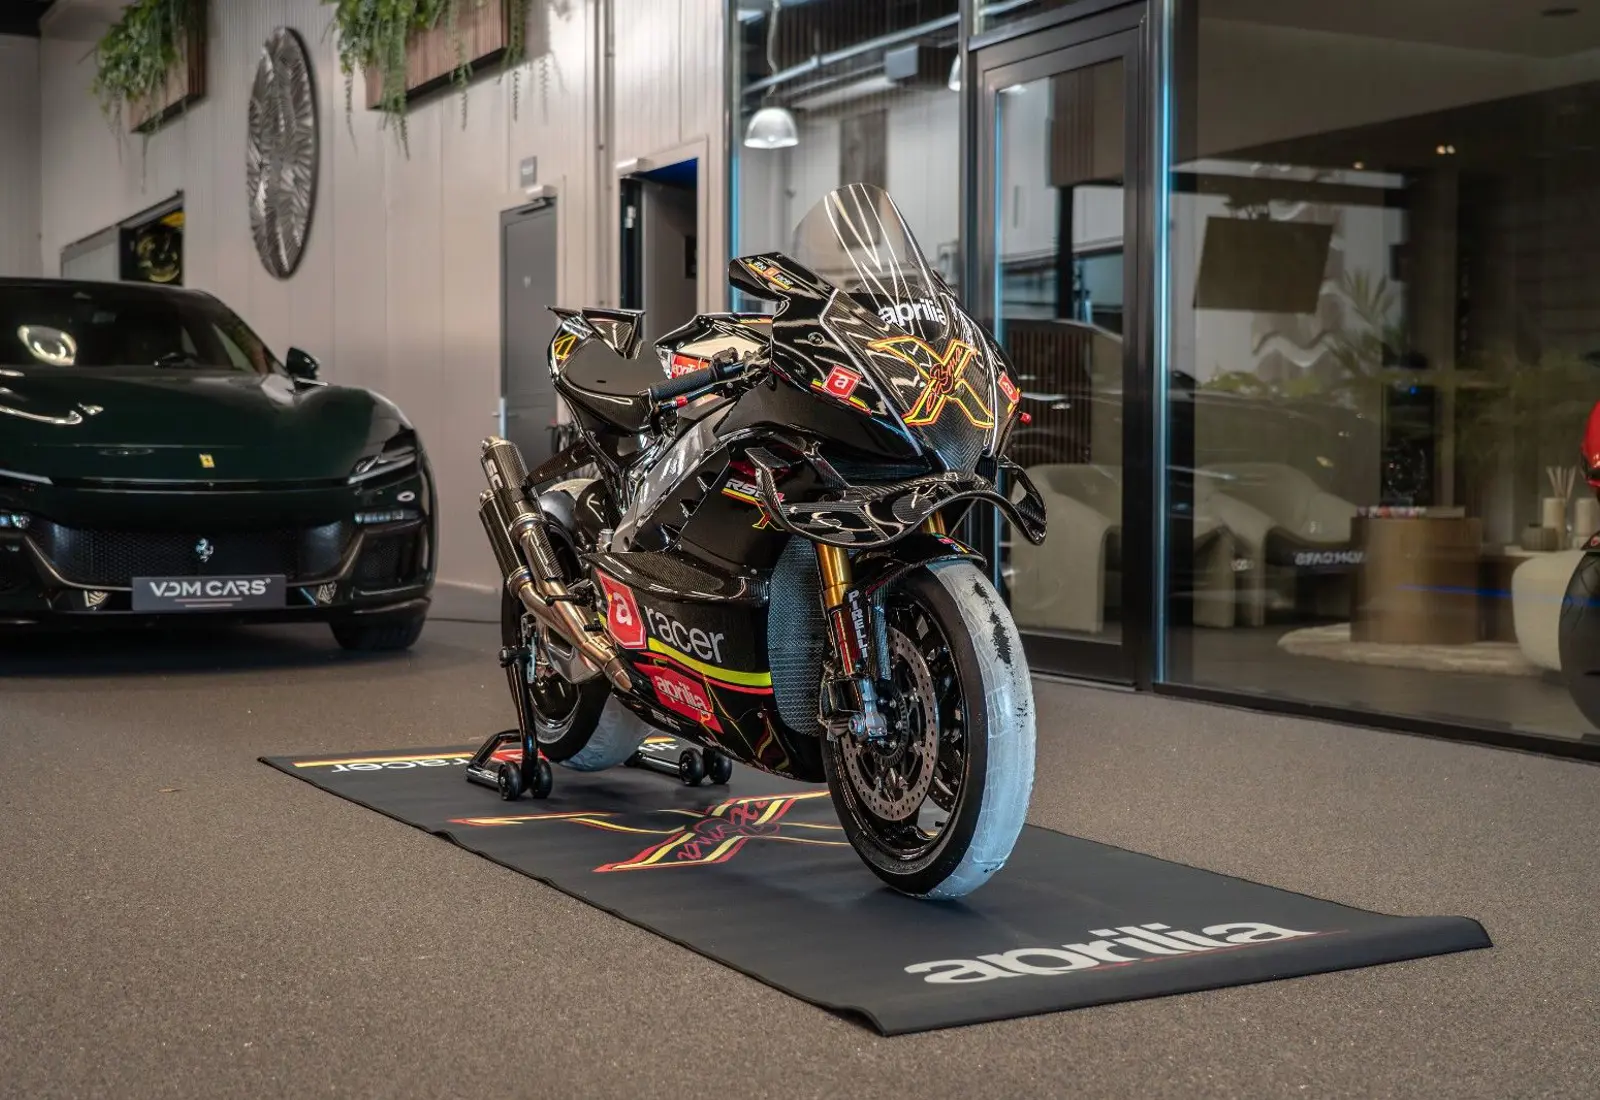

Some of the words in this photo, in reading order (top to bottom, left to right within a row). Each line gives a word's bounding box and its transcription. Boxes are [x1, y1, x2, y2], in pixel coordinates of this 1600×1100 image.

[878, 299, 947, 327] aprilia
[149, 581, 202, 597] VDM
[612, 592, 633, 626] a
[848, 589, 868, 658] PIRELLI
[644, 605, 725, 664] racer
[653, 675, 709, 715] aprilia
[331, 757, 470, 773] racer
[903, 922, 1319, 984] aprilia
